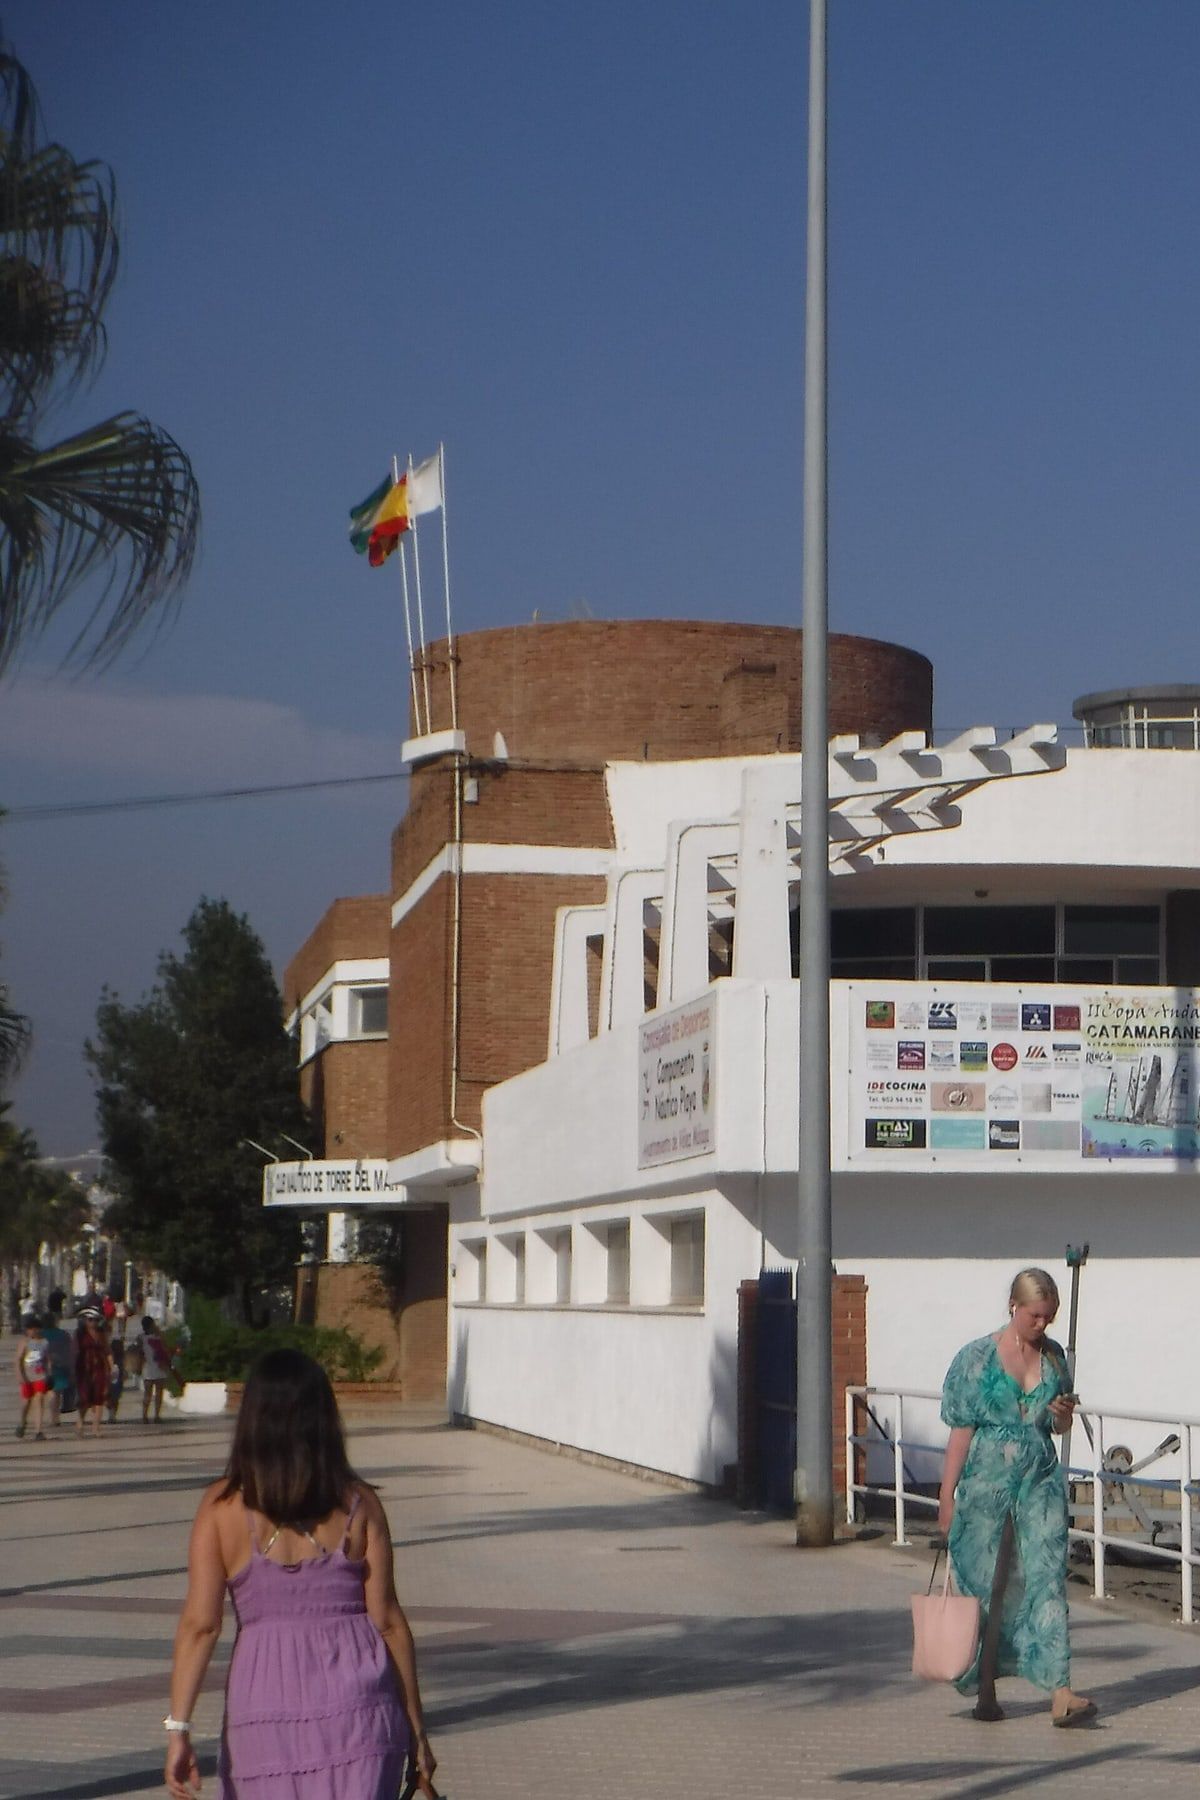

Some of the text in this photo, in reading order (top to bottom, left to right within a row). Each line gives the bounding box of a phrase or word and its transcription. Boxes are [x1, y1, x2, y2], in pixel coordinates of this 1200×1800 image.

[867, 1082, 927, 1091] IDECOCINA
[313, 1170, 324, 1193] DE
[326, 1169, 352, 1193] TORRE
[354, 1169, 372, 1192] DEL
[373, 1169, 400, 1192] MA
